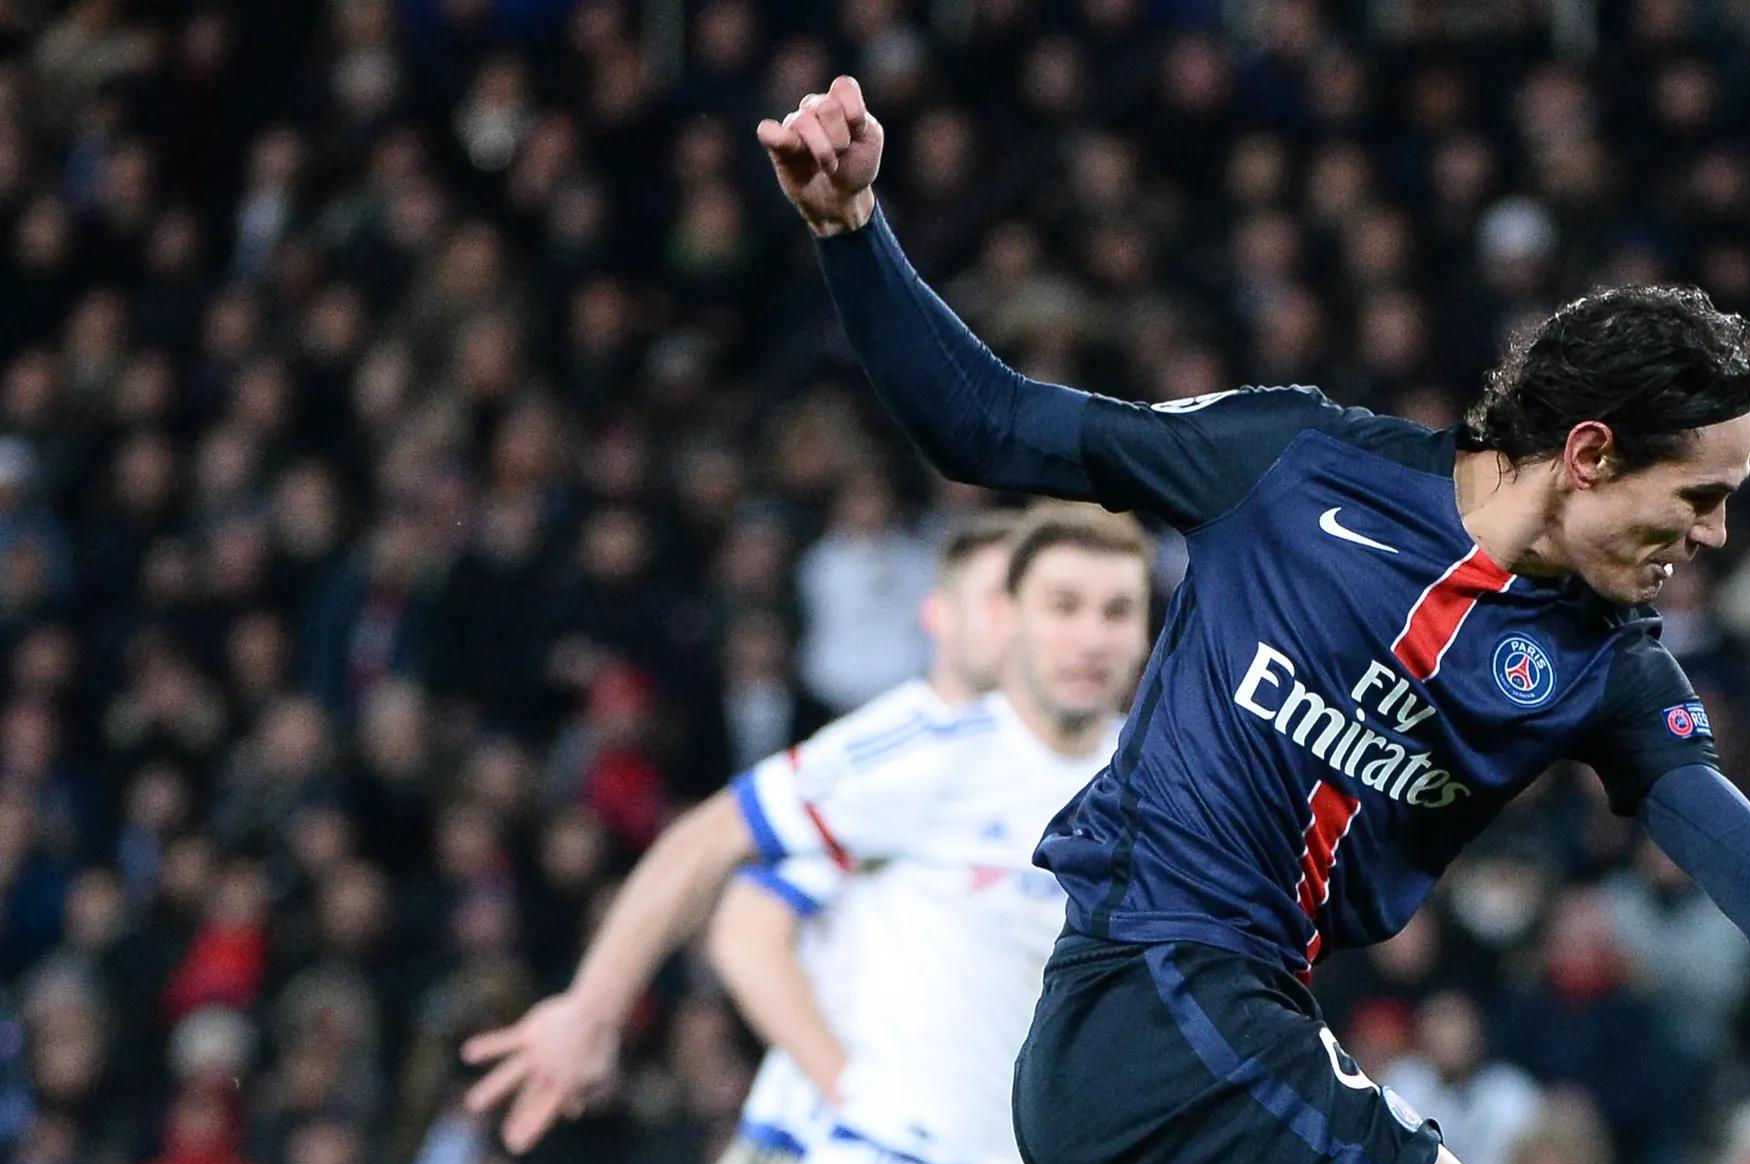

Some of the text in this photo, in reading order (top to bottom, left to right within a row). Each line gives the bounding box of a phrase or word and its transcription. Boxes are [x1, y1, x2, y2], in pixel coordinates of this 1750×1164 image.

[1510, 641, 1547, 670] PARIS
[1233, 641, 1472, 808] Emirates
[1351, 659, 1437, 733] Fly
